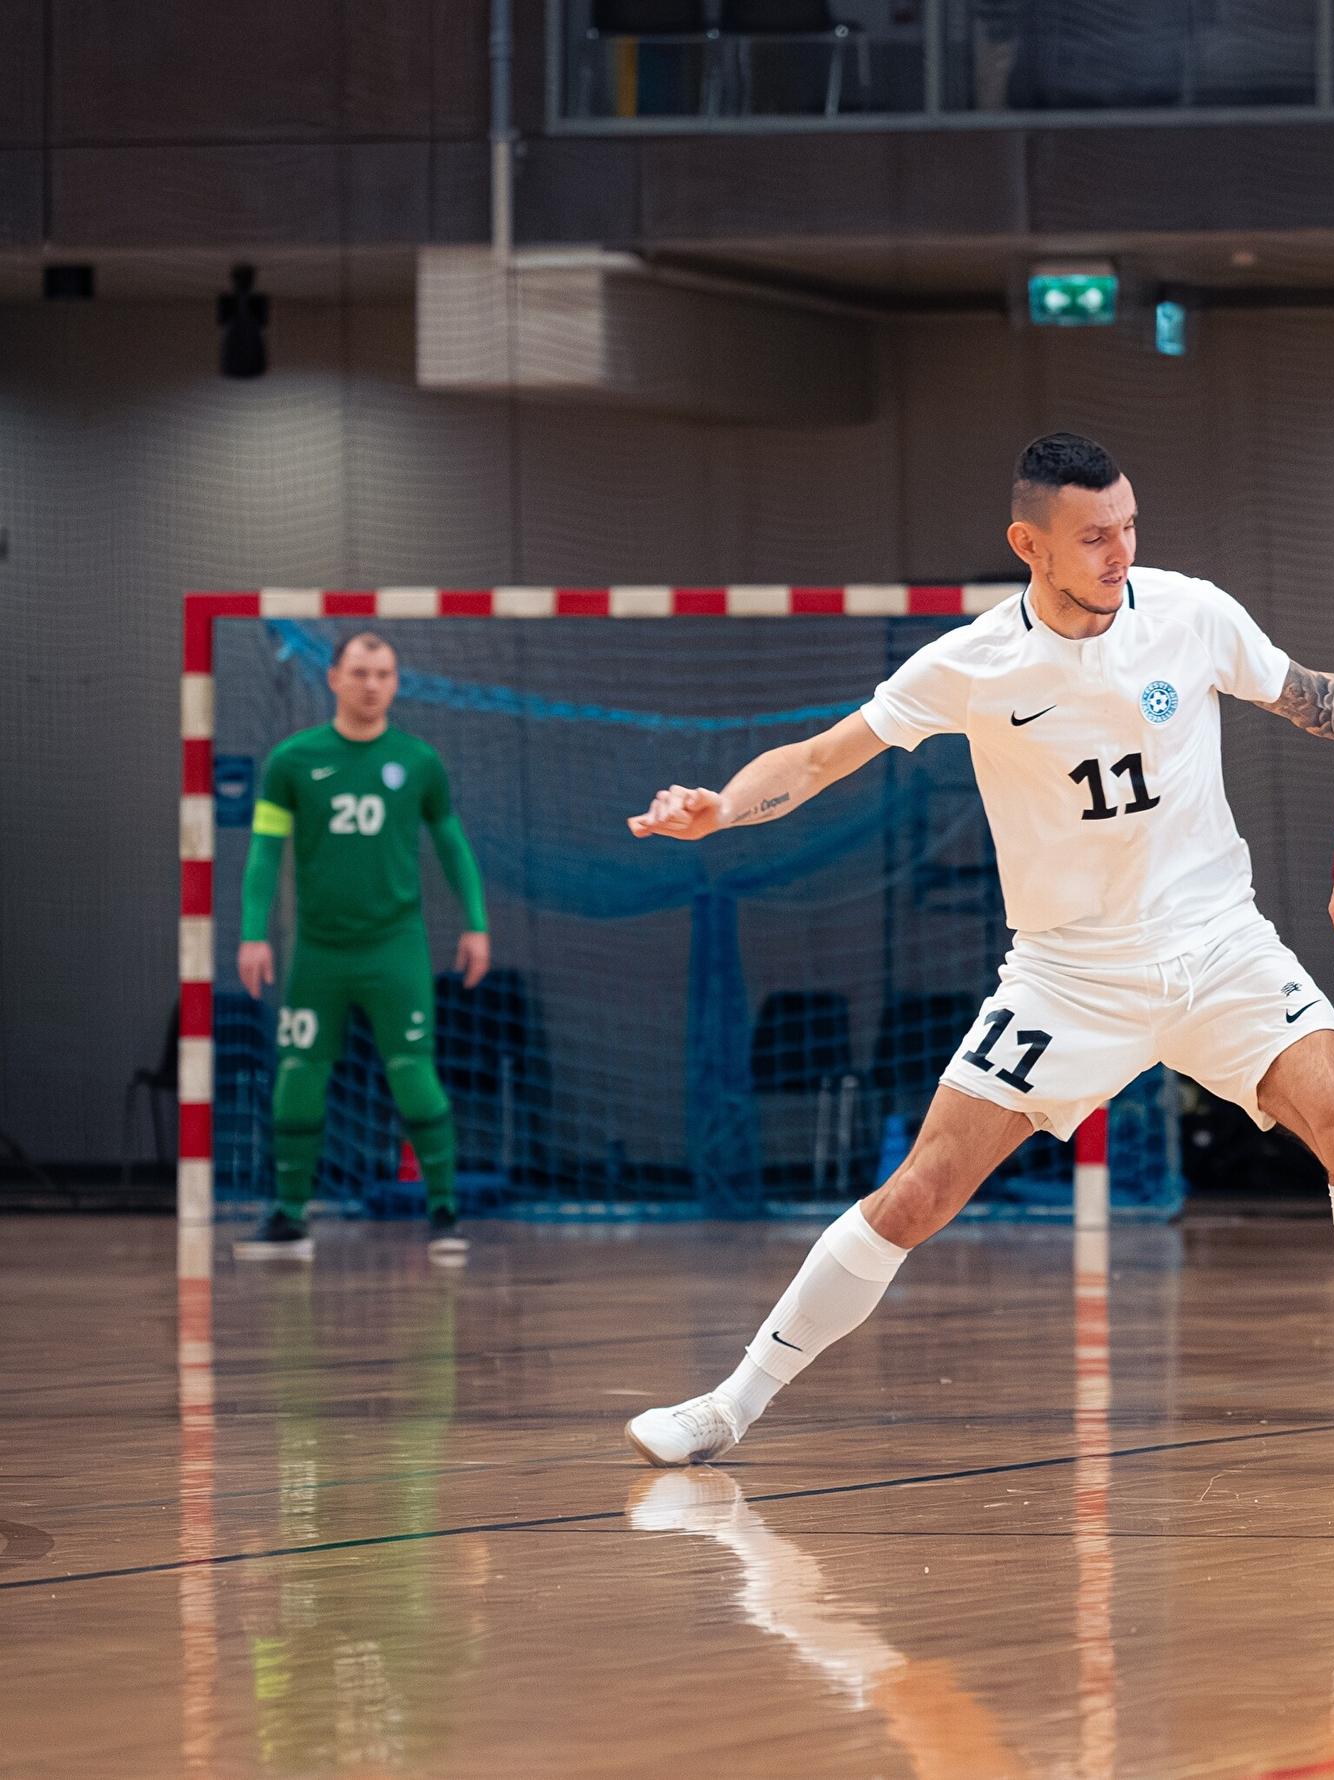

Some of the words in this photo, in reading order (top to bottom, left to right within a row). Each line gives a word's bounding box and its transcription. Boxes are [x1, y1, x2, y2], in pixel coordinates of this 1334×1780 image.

[329, 793, 386, 836] 20
[1068, 752, 1161, 821] 11
[277, 1006, 318, 1049] 20
[961, 1008, 1054, 1093] 11
